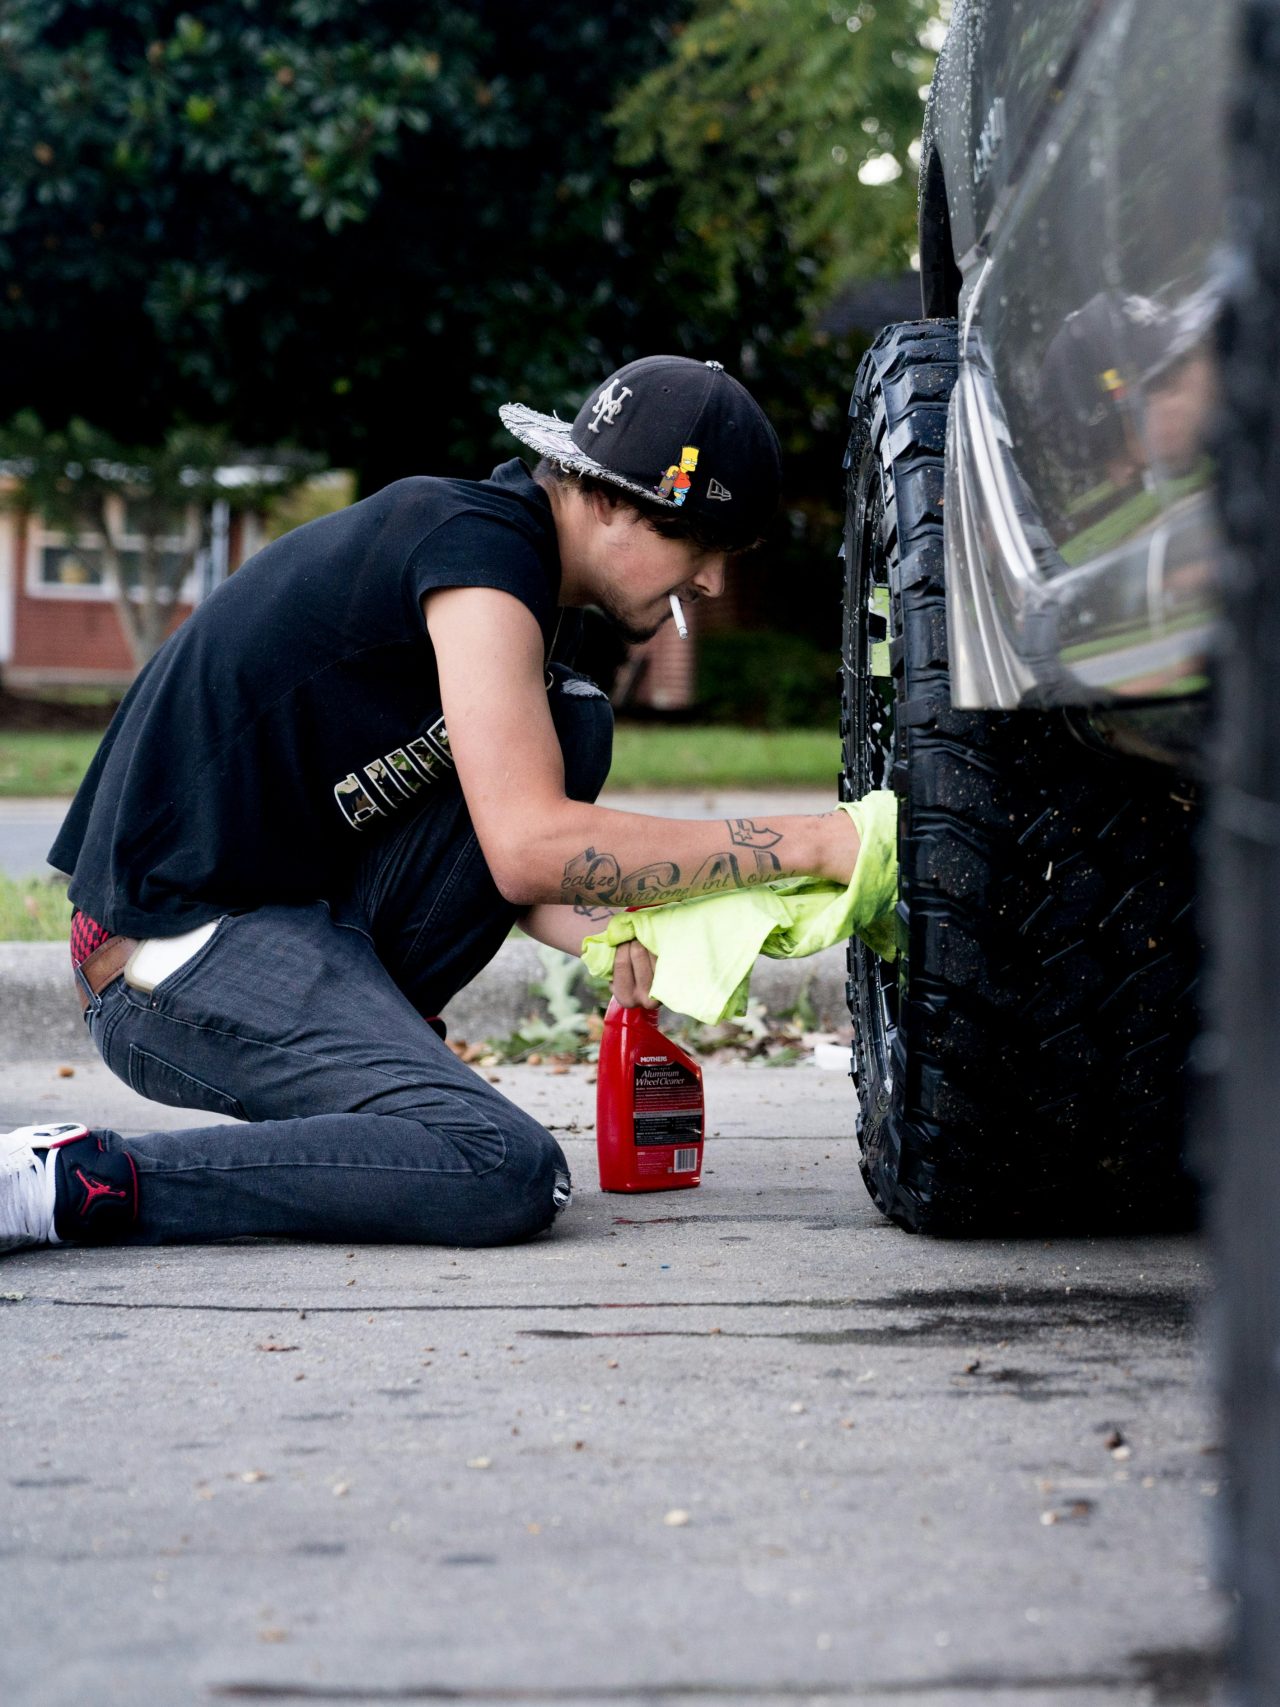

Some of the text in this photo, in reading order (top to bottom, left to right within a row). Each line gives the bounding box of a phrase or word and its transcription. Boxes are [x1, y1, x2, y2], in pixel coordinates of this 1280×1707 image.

[641, 1070, 680, 1078] Aluminum
[636, 1077, 685, 1086] Wheel Cleaner
